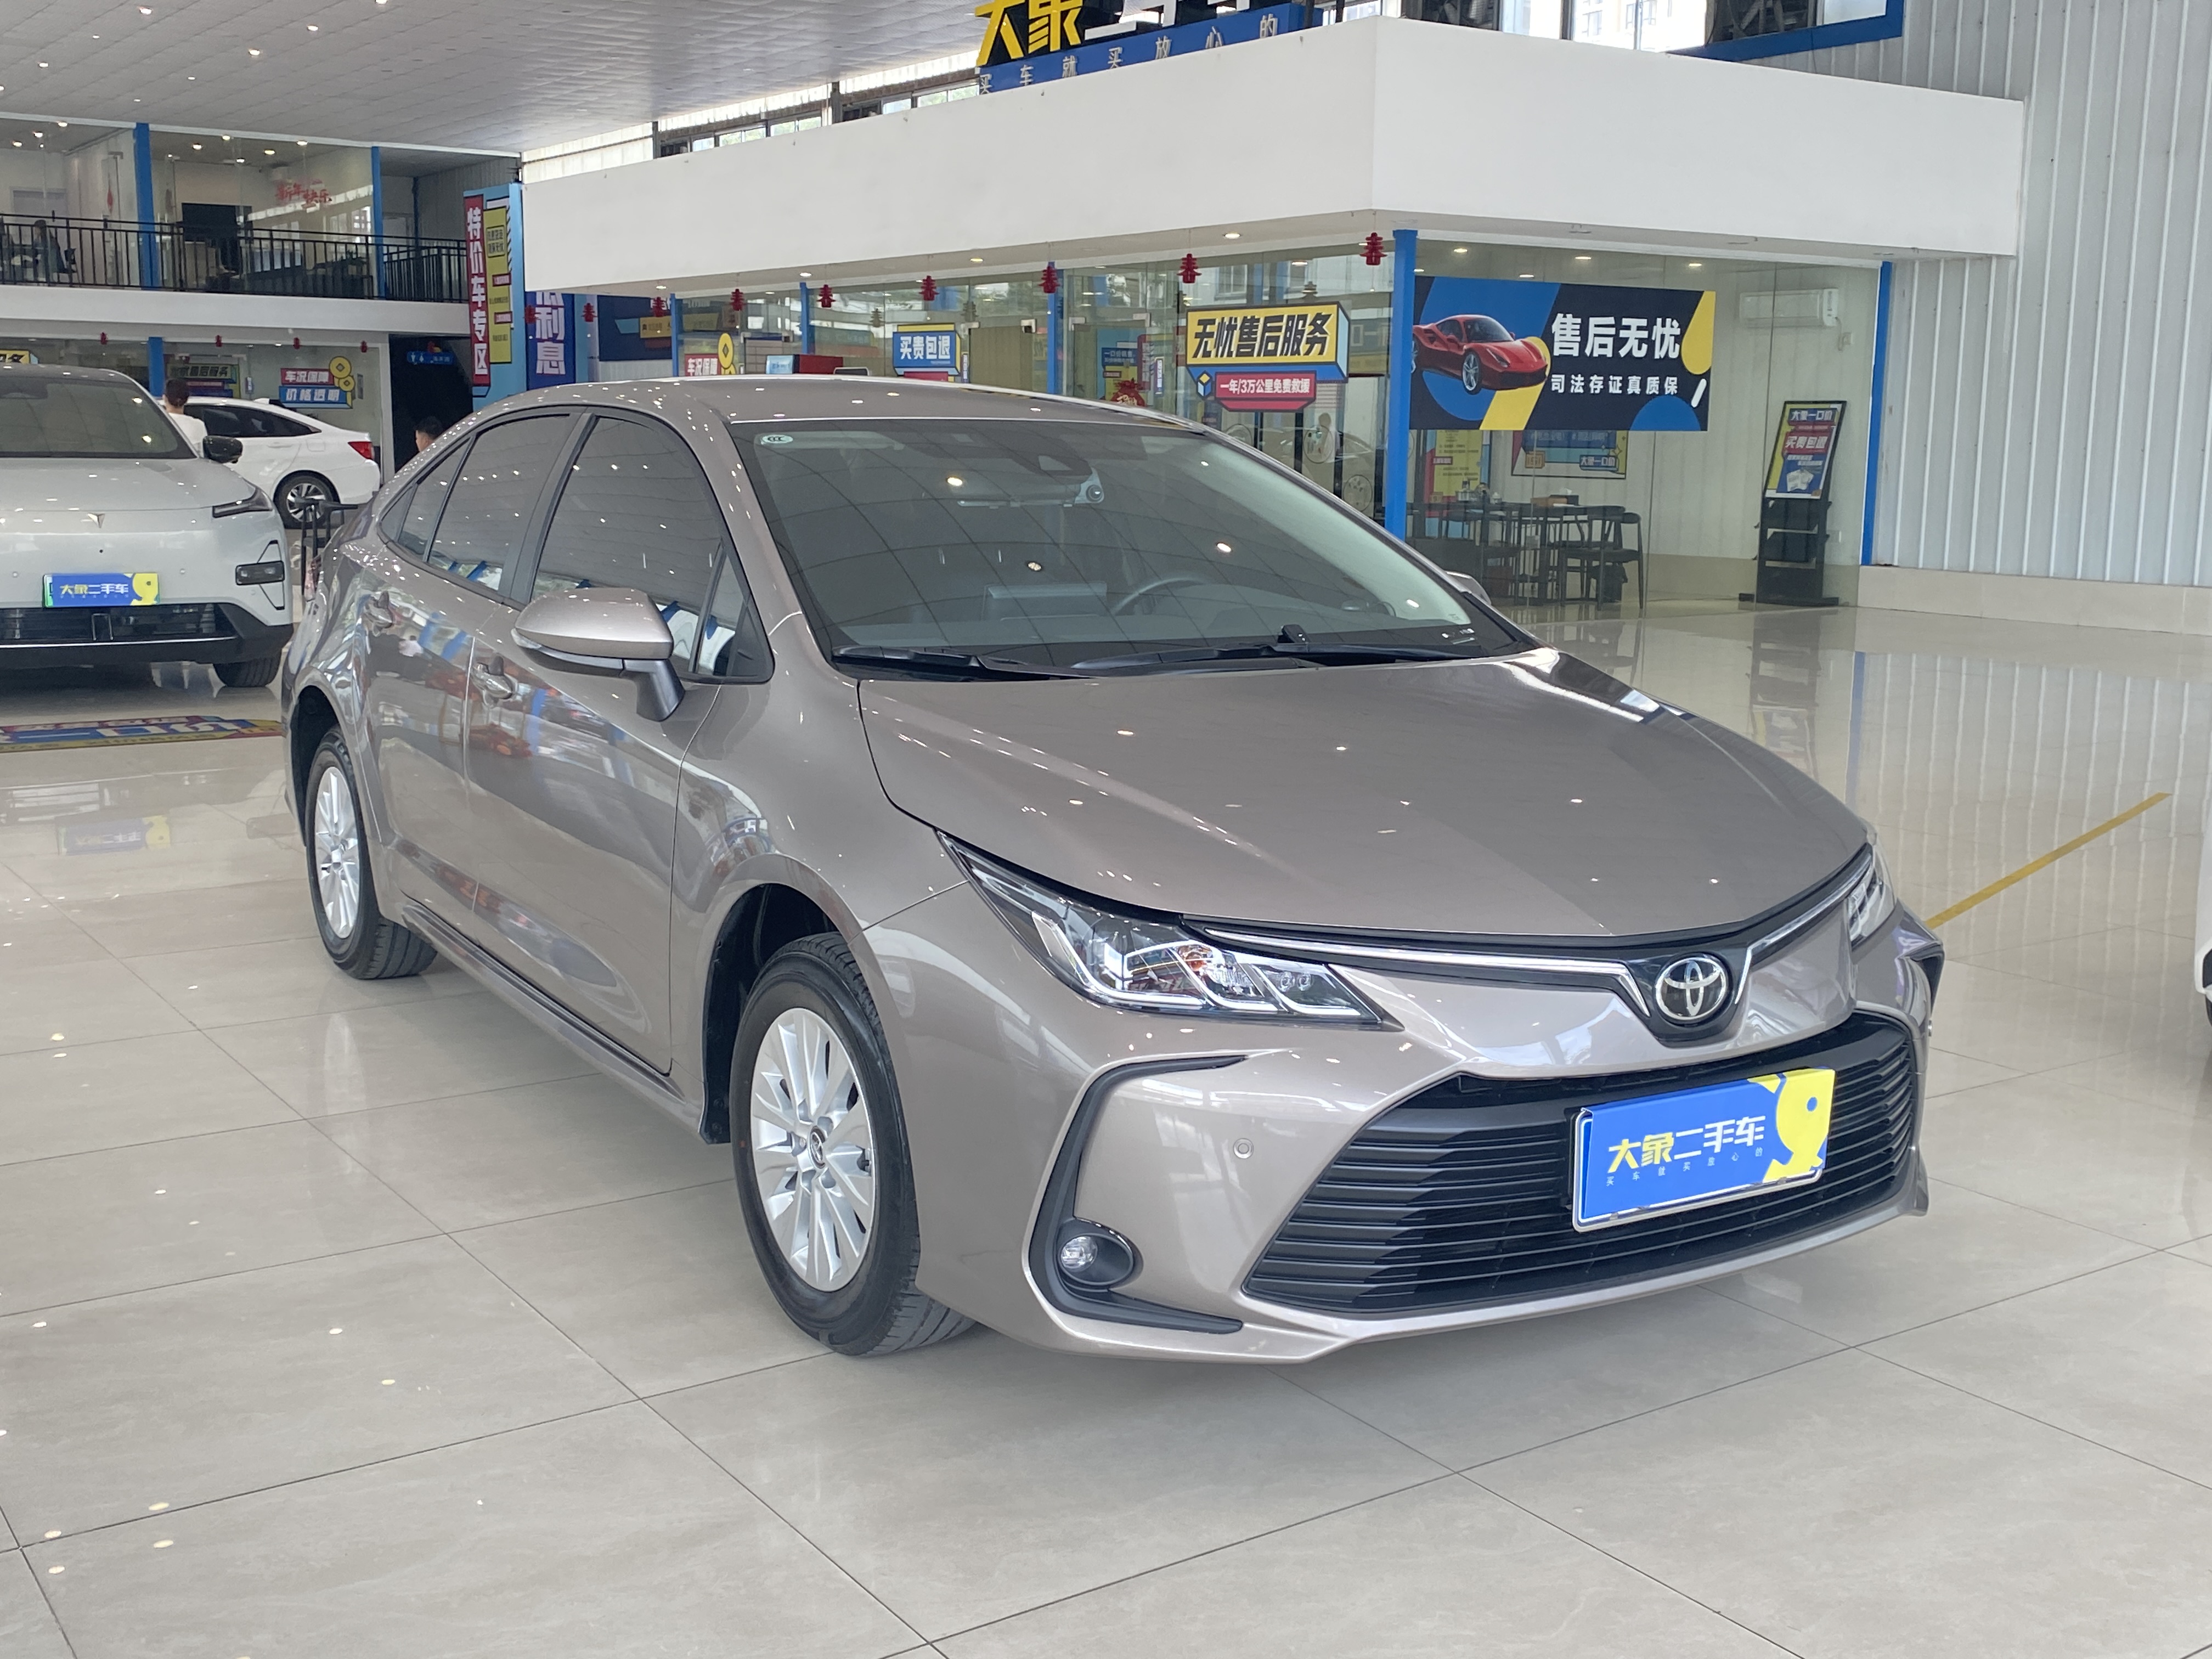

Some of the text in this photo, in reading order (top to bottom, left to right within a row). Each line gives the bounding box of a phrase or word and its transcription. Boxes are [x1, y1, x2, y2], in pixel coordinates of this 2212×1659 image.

[467, 207, 489, 375] 特价车专区
[900, 335, 951, 359] 买贵包退
[1192, 312, 1334, 358] 无忧售后服务
[1551, 313, 1680, 359] 售后无忧
[1551, 374, 1678, 395] 司法存证真质保
[60, 583, 129, 595] 大象二手车
[1607, 1116, 1765, 1173] 大象二手车
[1606, 1147, 1763, 1187] 买车就买放心的
